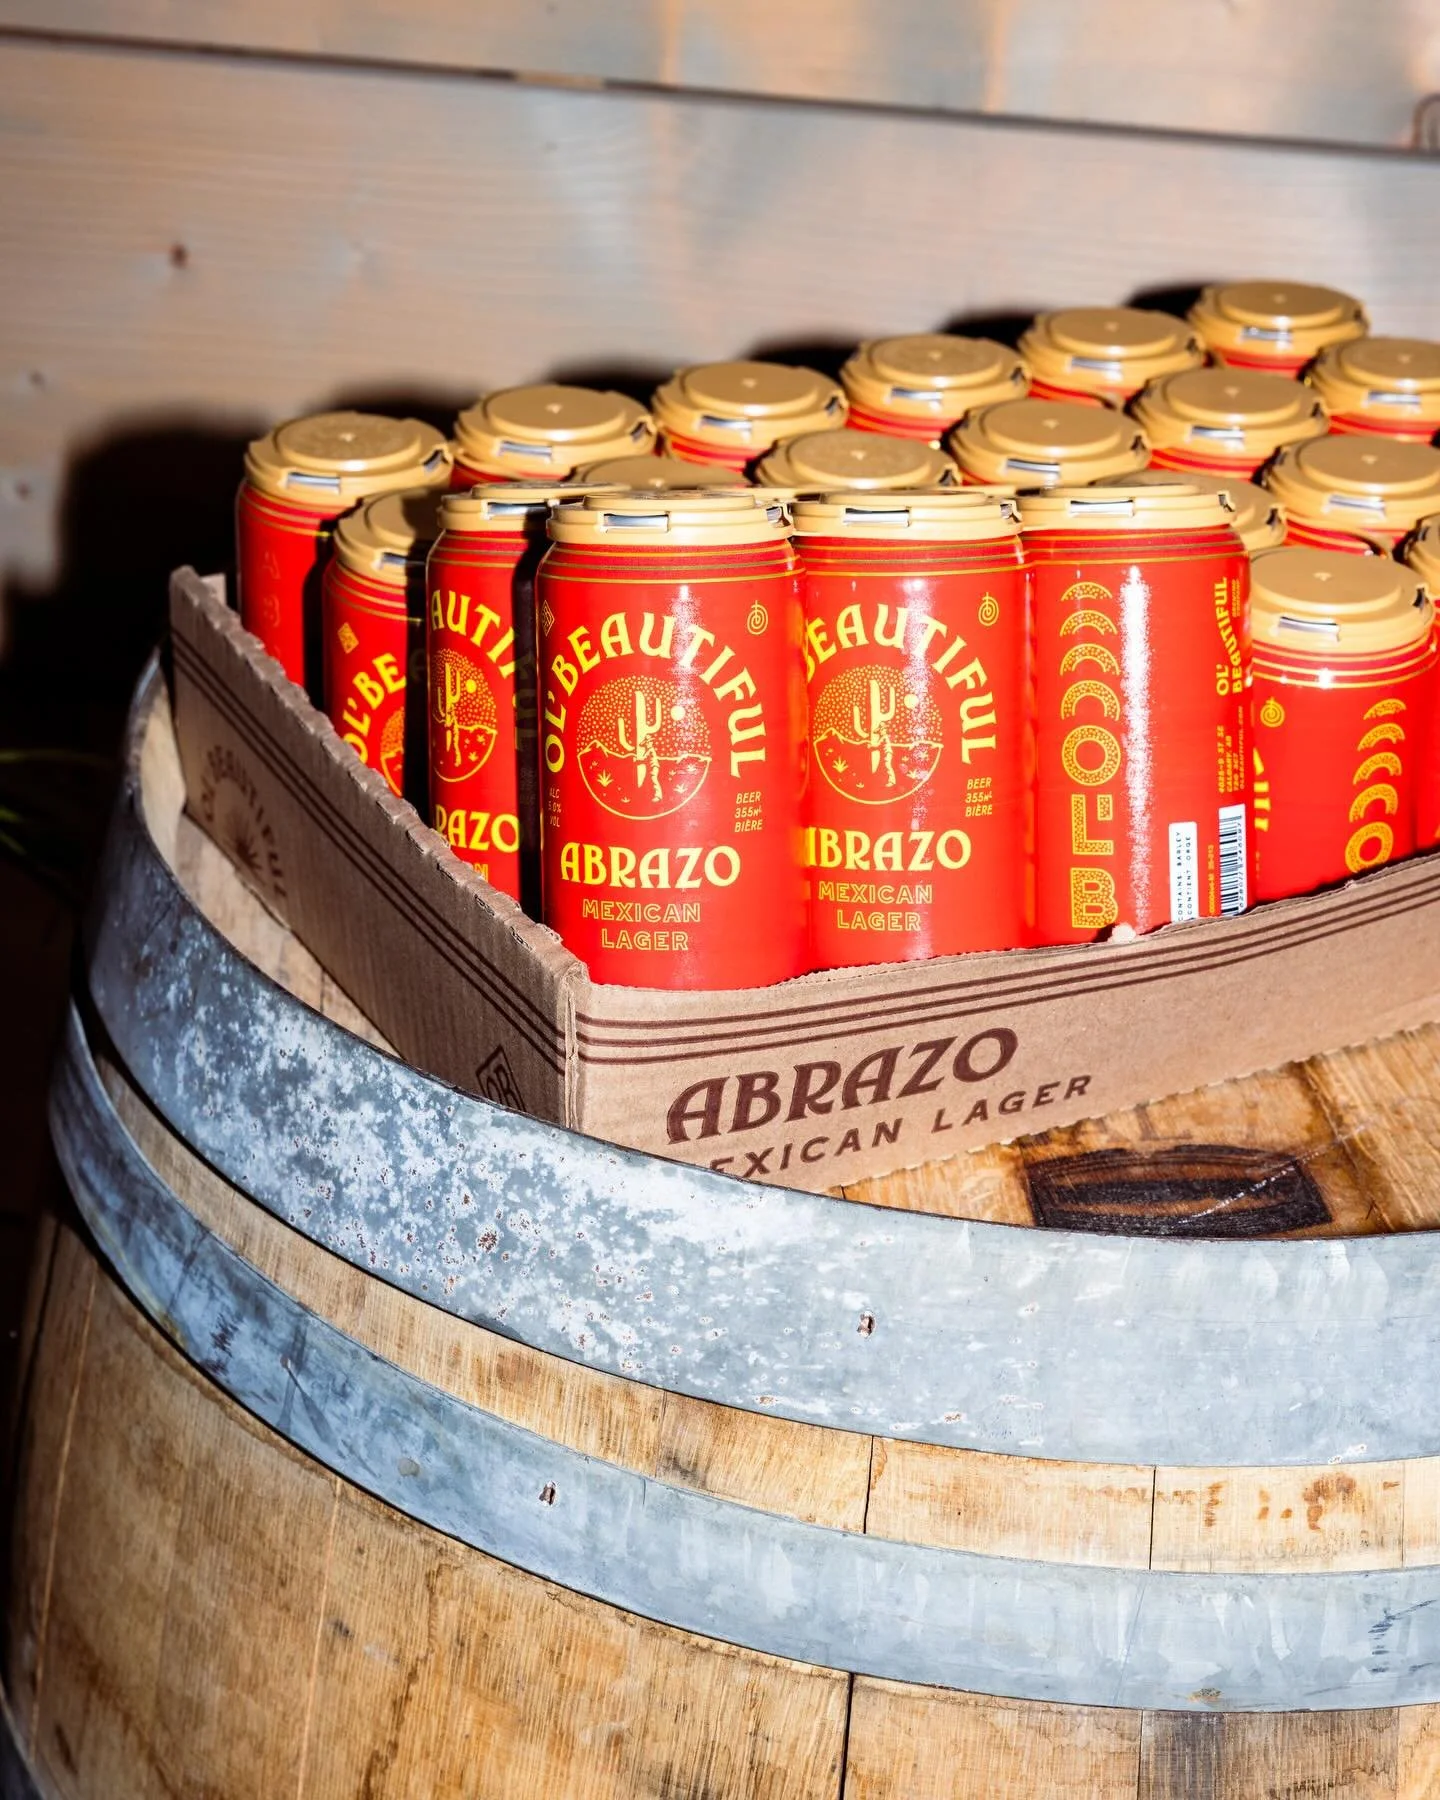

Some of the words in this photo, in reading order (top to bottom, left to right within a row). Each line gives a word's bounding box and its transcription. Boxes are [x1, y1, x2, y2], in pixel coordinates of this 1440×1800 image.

[1215, 577, 1242, 693] BEAUTIFUL
[352, 652, 408, 711] BE
[552, 611, 767, 778] BEAUTIFUL
[736, 791, 762, 805] BEER
[967, 776, 992, 790] BEER
[560, 841, 741, 889] ABRAZO
[582, 898, 701, 923] MEXICAN
[818, 880, 933, 905] MEXICAN
[836, 909, 921, 932] LAGER
[601, 927, 689, 952] LAGER
[666, 1027, 1018, 1145] ABRAZO
[710, 1117, 903, 1179] EXICAN
[931, 1074, 1093, 1134] LAGER
